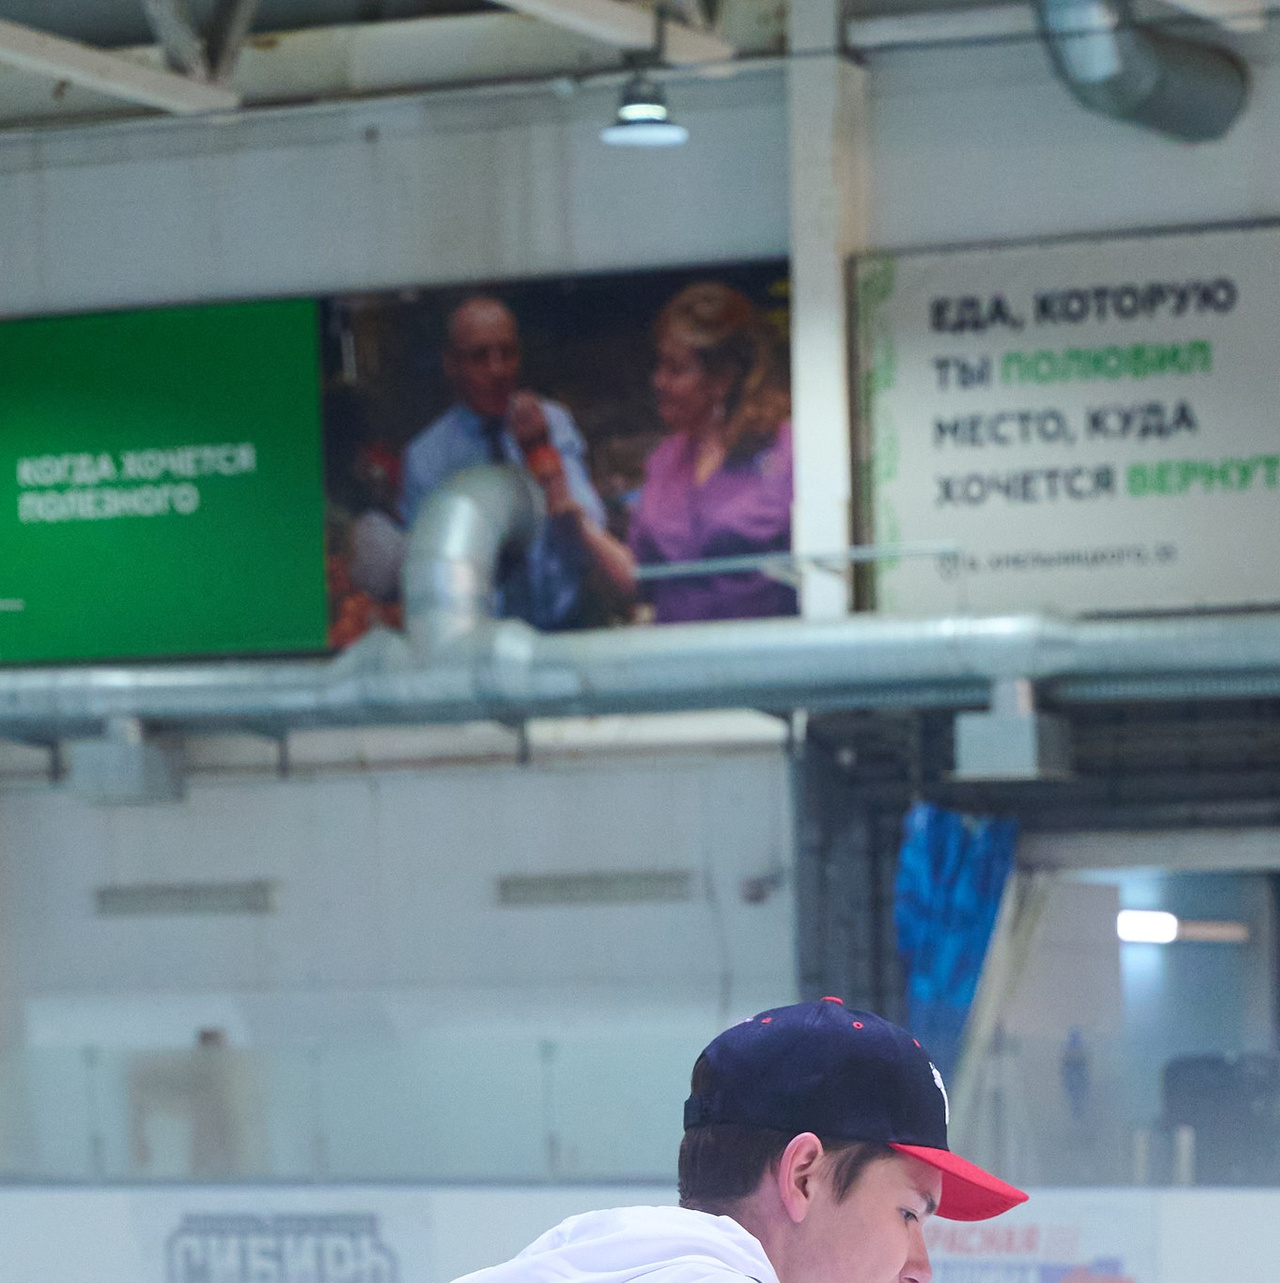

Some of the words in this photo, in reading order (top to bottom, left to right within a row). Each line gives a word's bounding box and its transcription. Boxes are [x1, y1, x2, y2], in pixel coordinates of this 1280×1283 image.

[930, 292, 1024, 334] ЕДА,
[1033, 277, 1238, 325] КОТОРУЮ
[933, 355, 992, 390] ТЫ
[1002, 339, 1213, 384] ПОЛЮБИЛ
[933, 409, 1077, 447] МЕСТО,
[1087, 400, 1198, 441] КУДА
[17, 452, 117, 486] КОГДА
[120, 442, 256, 479] ХОЧЕТСЯ
[936, 463, 1116, 507] ХОЧЕТСЯ
[17, 482, 200, 523] ПОЛЕЗНОГО
[923, 1224, 1040, 1255] РАСНАЯ
